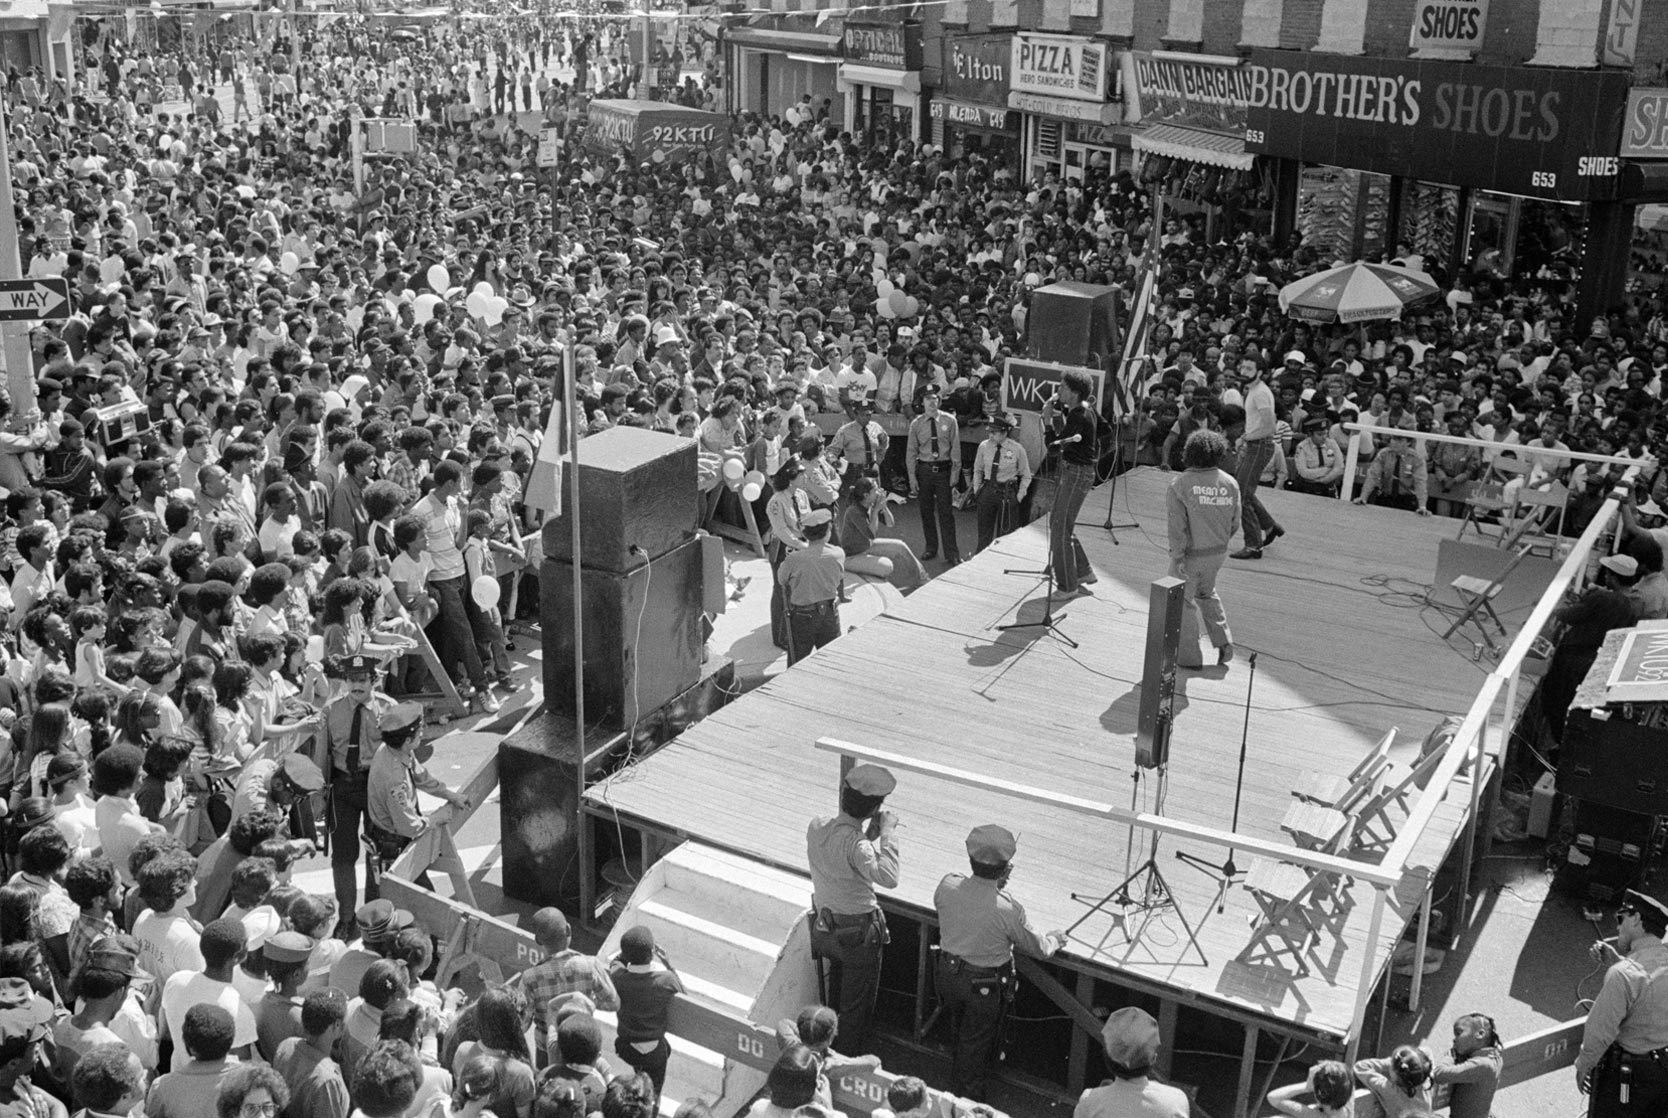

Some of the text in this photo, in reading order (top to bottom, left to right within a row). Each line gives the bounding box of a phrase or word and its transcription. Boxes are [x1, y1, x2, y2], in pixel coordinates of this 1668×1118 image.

[1420, 5, 1480, 40] SHOES
[845, 28, 905, 54] OPTICAL
[953, 45, 1003, 81] Elton
[1020, 43, 1074, 75] PIZZA
[1020, 73, 1035, 85] HERO
[1037, 75, 1074, 89] SANDWICHES
[1137, 60, 1181, 98] DANN
[1249, 65, 1561, 142] BROTHER'S SHOES
[990, 112, 1004, 129] 649
[653, 126, 715, 142] 92KTU
[1246, 129, 1265, 144] 653
[1578, 156, 1619, 176] SHOES
[1532, 171, 1556, 188] 653
[10, 291, 49, 308] WAY
[738, 1033, 763, 1058] DO
[840, 1076, 889, 1103] CRO
